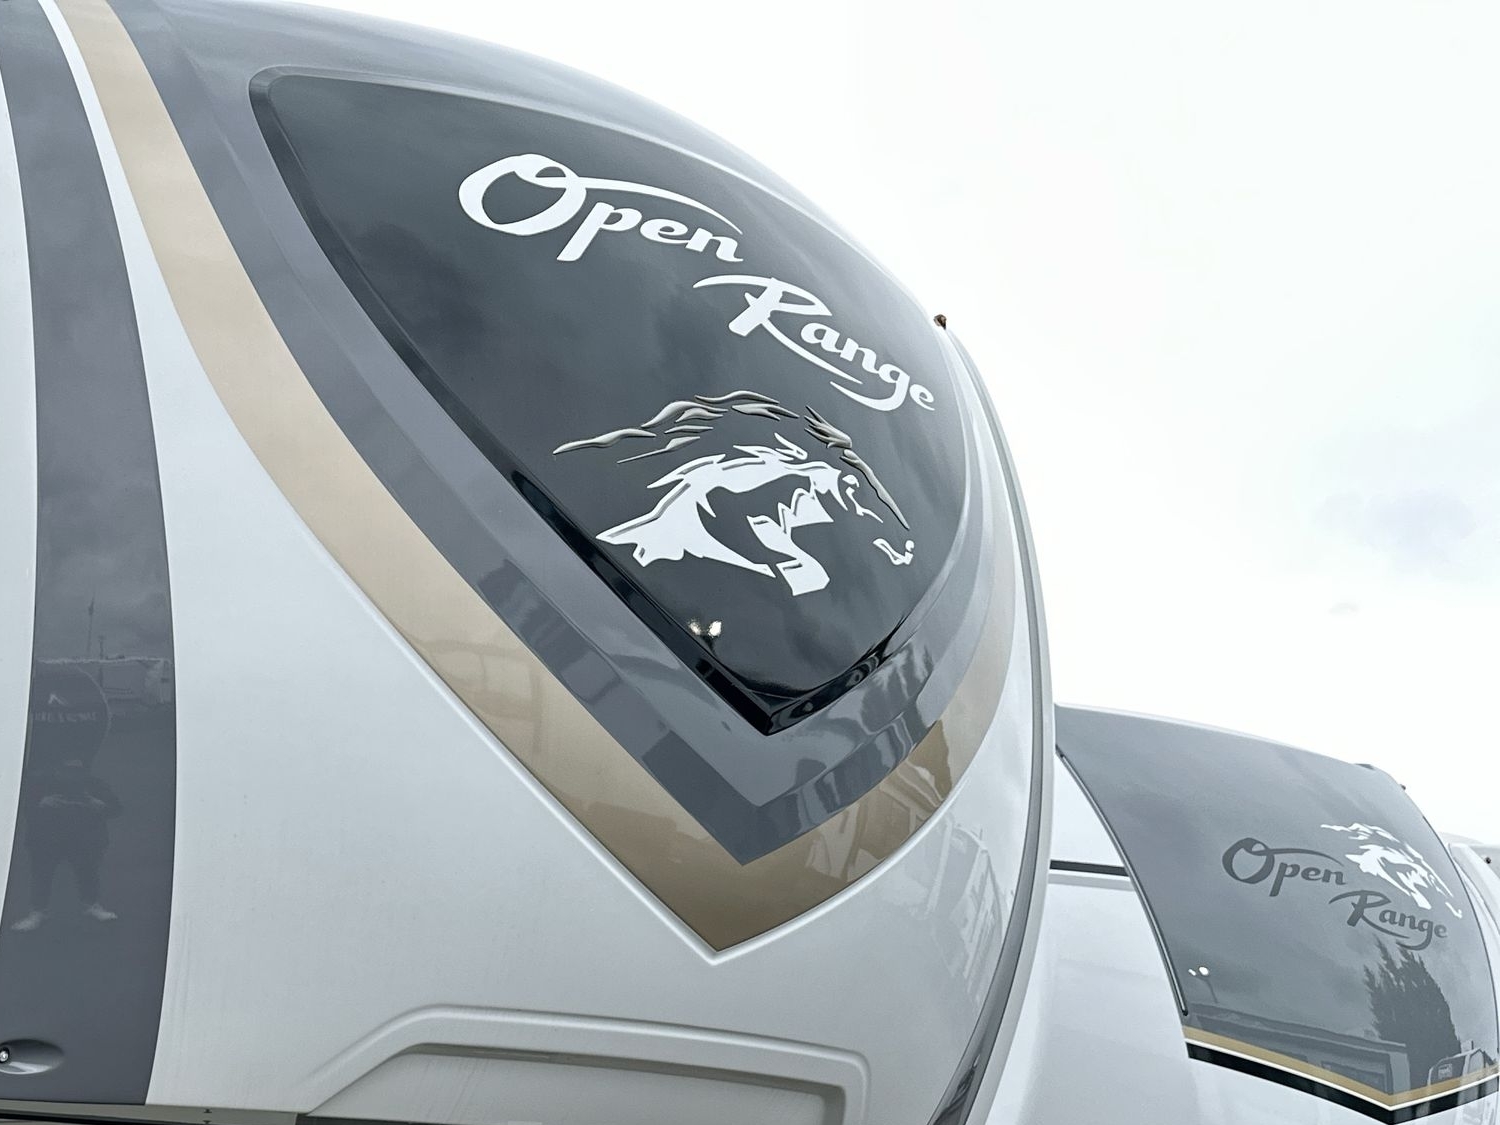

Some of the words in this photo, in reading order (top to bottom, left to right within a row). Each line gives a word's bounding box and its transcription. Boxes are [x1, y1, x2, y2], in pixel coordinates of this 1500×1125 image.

[457, 152, 743, 262] Open
[693, 274, 935, 412] Range
[1222, 837, 1348, 898] Open
[1329, 889, 1447, 950] Range
